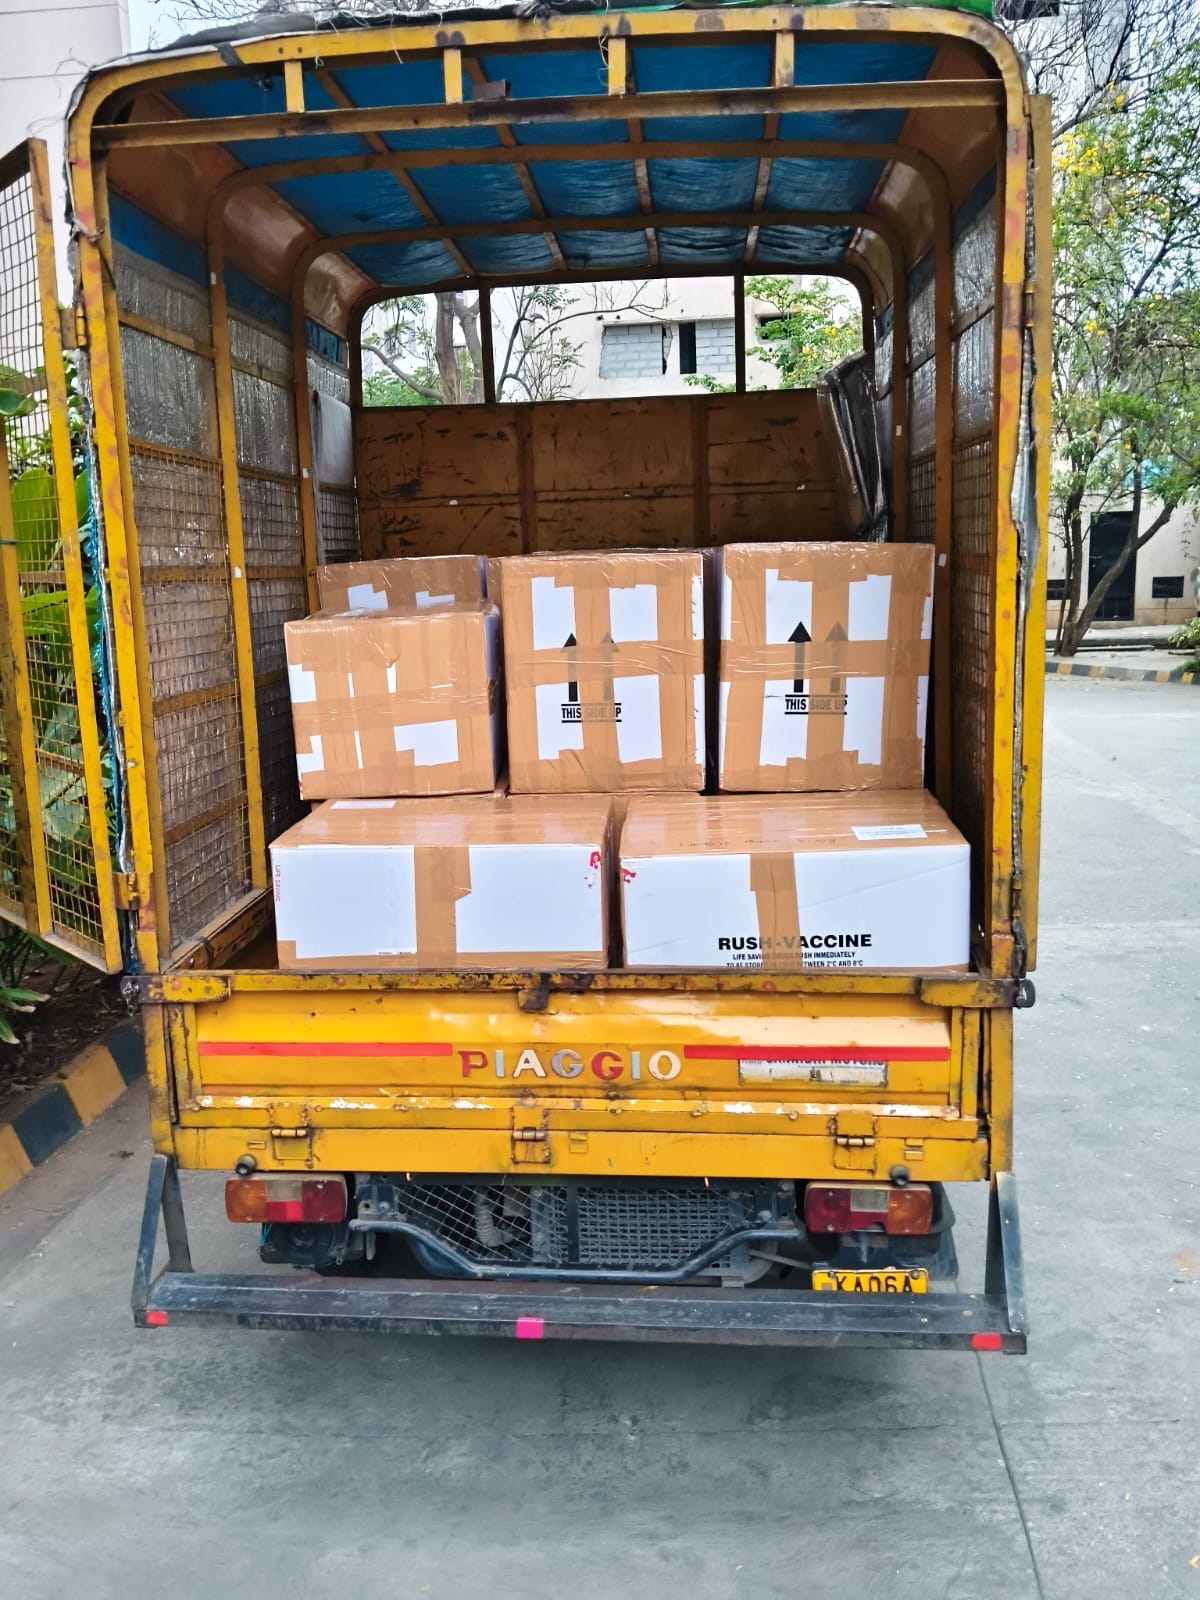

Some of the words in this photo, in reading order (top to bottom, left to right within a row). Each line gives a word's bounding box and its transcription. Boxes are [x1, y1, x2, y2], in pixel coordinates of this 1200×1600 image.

[784, 698, 807, 711] THIS
[809, 698, 832, 711] SIDE
[834, 698, 848, 711] UP
[561, 707, 582, 719] THIS
[609, 706, 622, 718] UP
[813, 951, 856, 959] IMMEDIATELY
[457, 1048, 682, 1081] PIAGGIO
